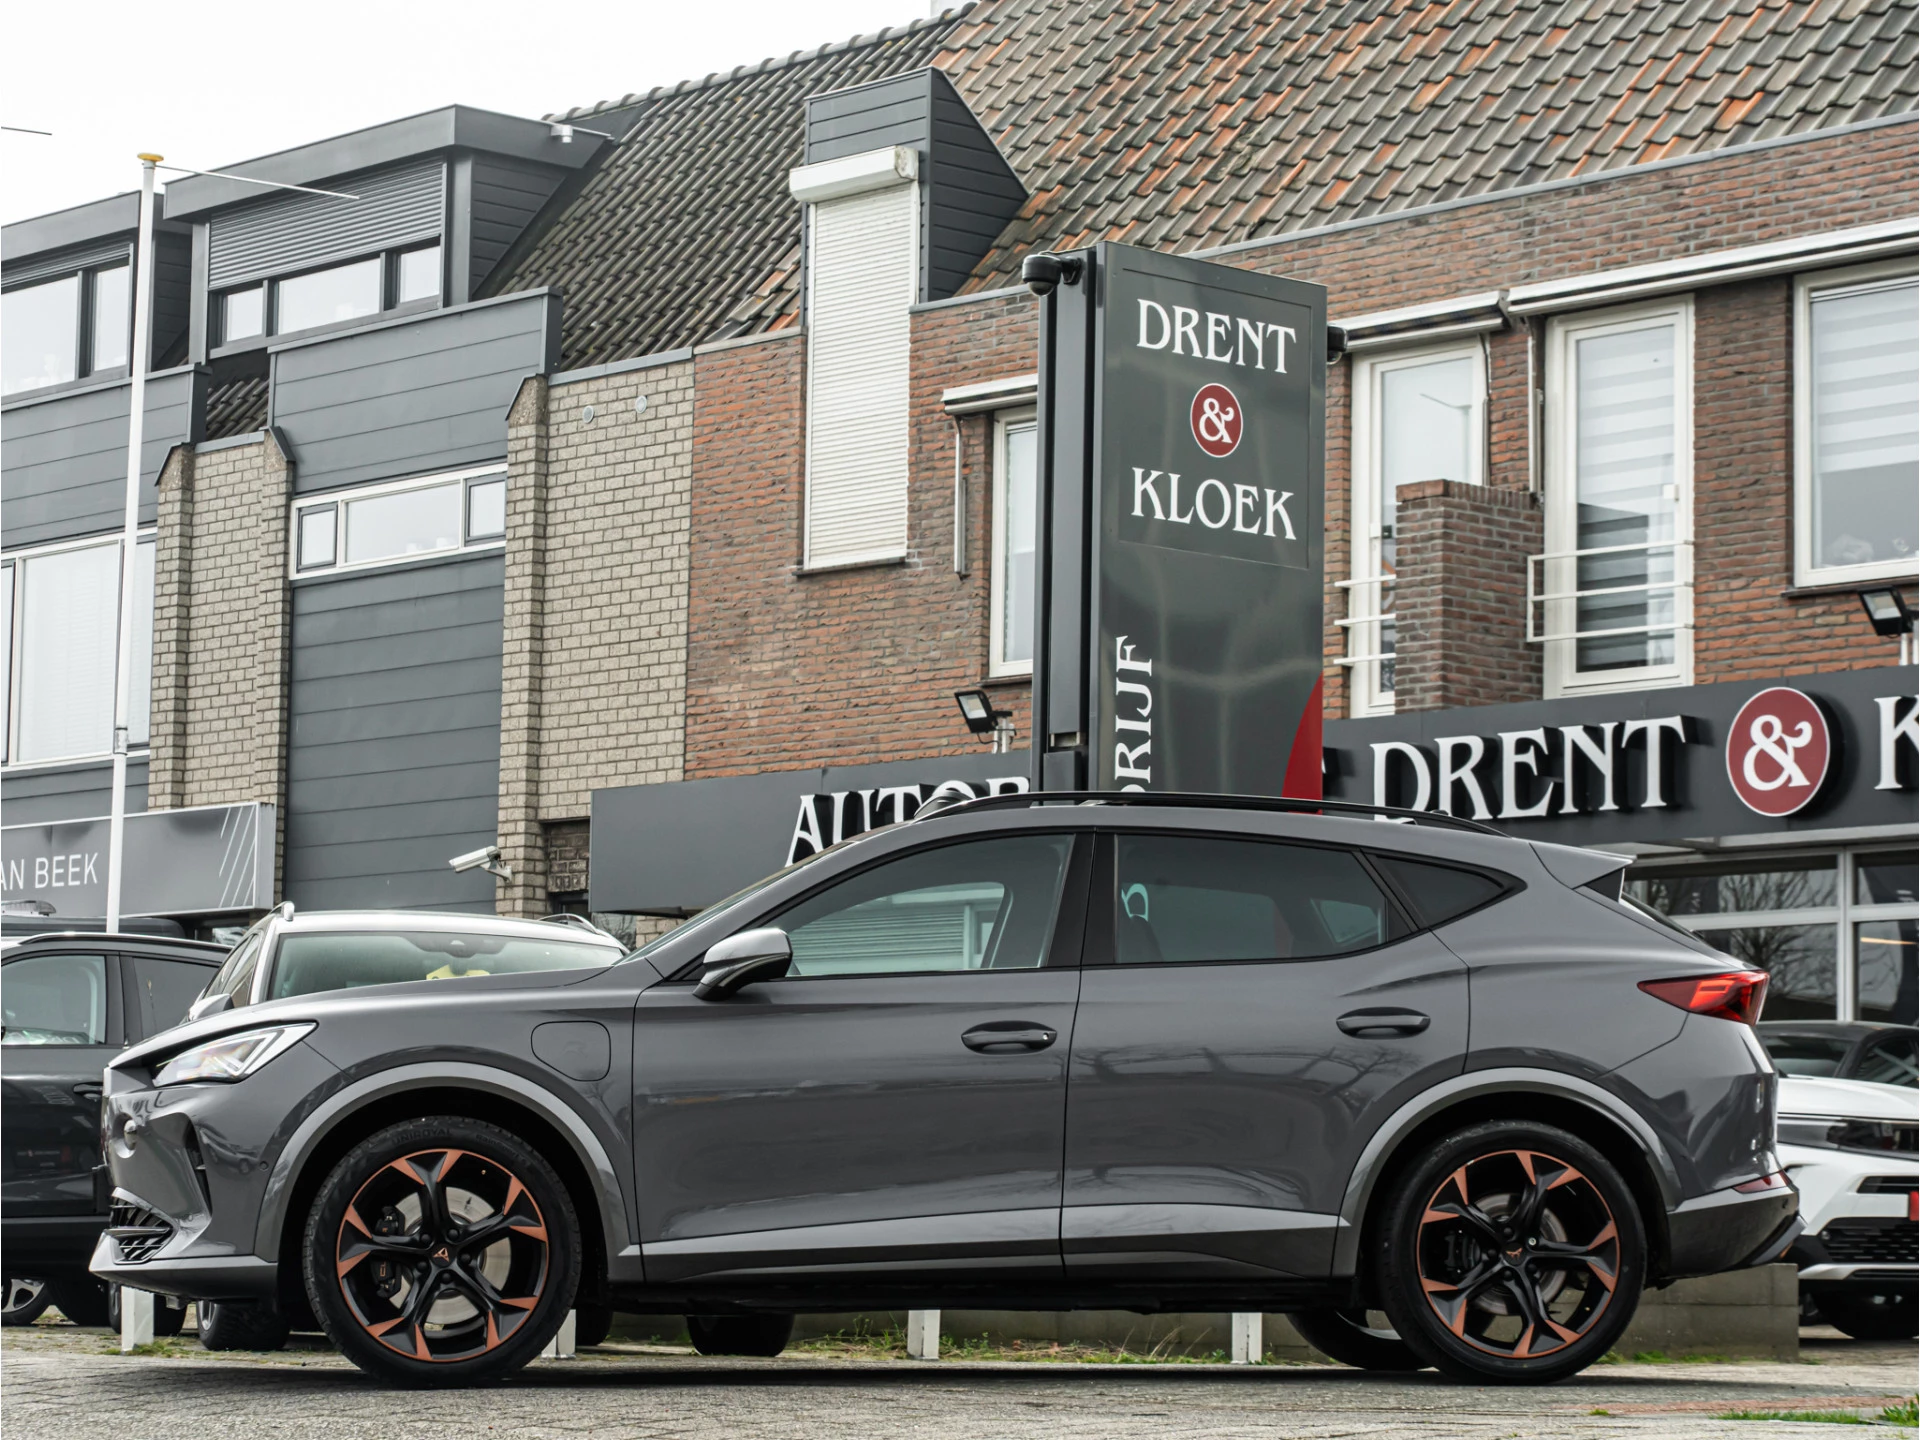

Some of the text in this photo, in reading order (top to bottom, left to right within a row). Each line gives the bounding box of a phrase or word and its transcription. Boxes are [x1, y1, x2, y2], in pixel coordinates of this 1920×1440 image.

[1136, 298, 1297, 374] DRENT
[1198, 397, 1235, 444] &
[1131, 466, 1297, 540] KLOEK
[1114, 635, 1153, 793] RIJF
[1370, 715, 1687, 824] DRENT
[1743, 714, 1812, 791] &
[35, 852, 99, 889] BEEK
